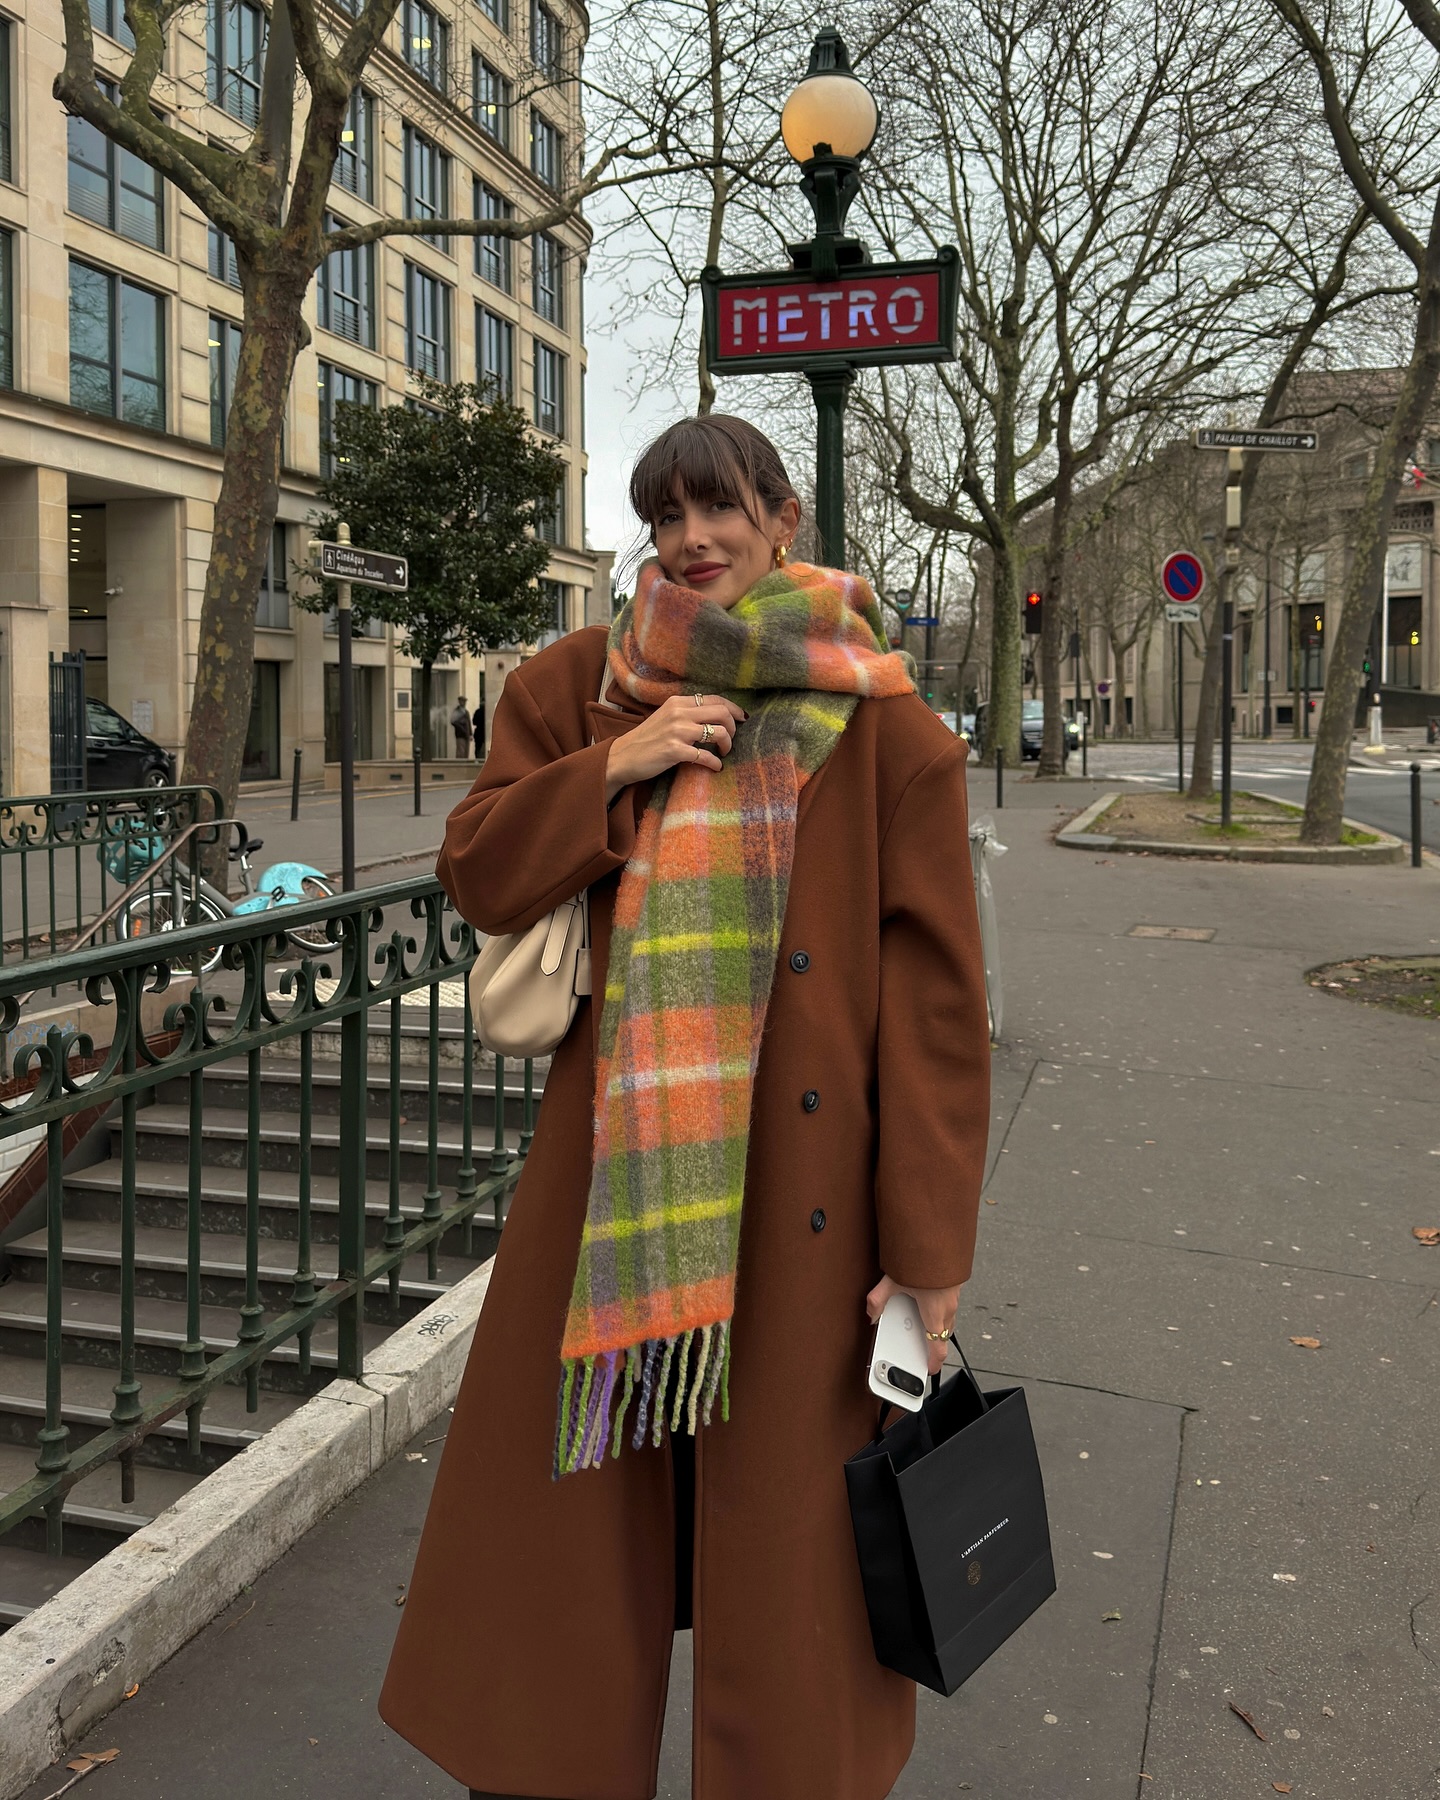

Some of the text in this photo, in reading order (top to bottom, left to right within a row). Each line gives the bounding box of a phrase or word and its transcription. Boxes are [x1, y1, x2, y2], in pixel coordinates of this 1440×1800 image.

[733, 287, 924, 346] METRO
[1215, 433, 1298, 446] PALAIS DE CHAILLOT
[336, 562, 357, 574] Aquarium
[357, 567, 364, 576] du
[961, 1538, 984, 1558] L'ARTISAN
